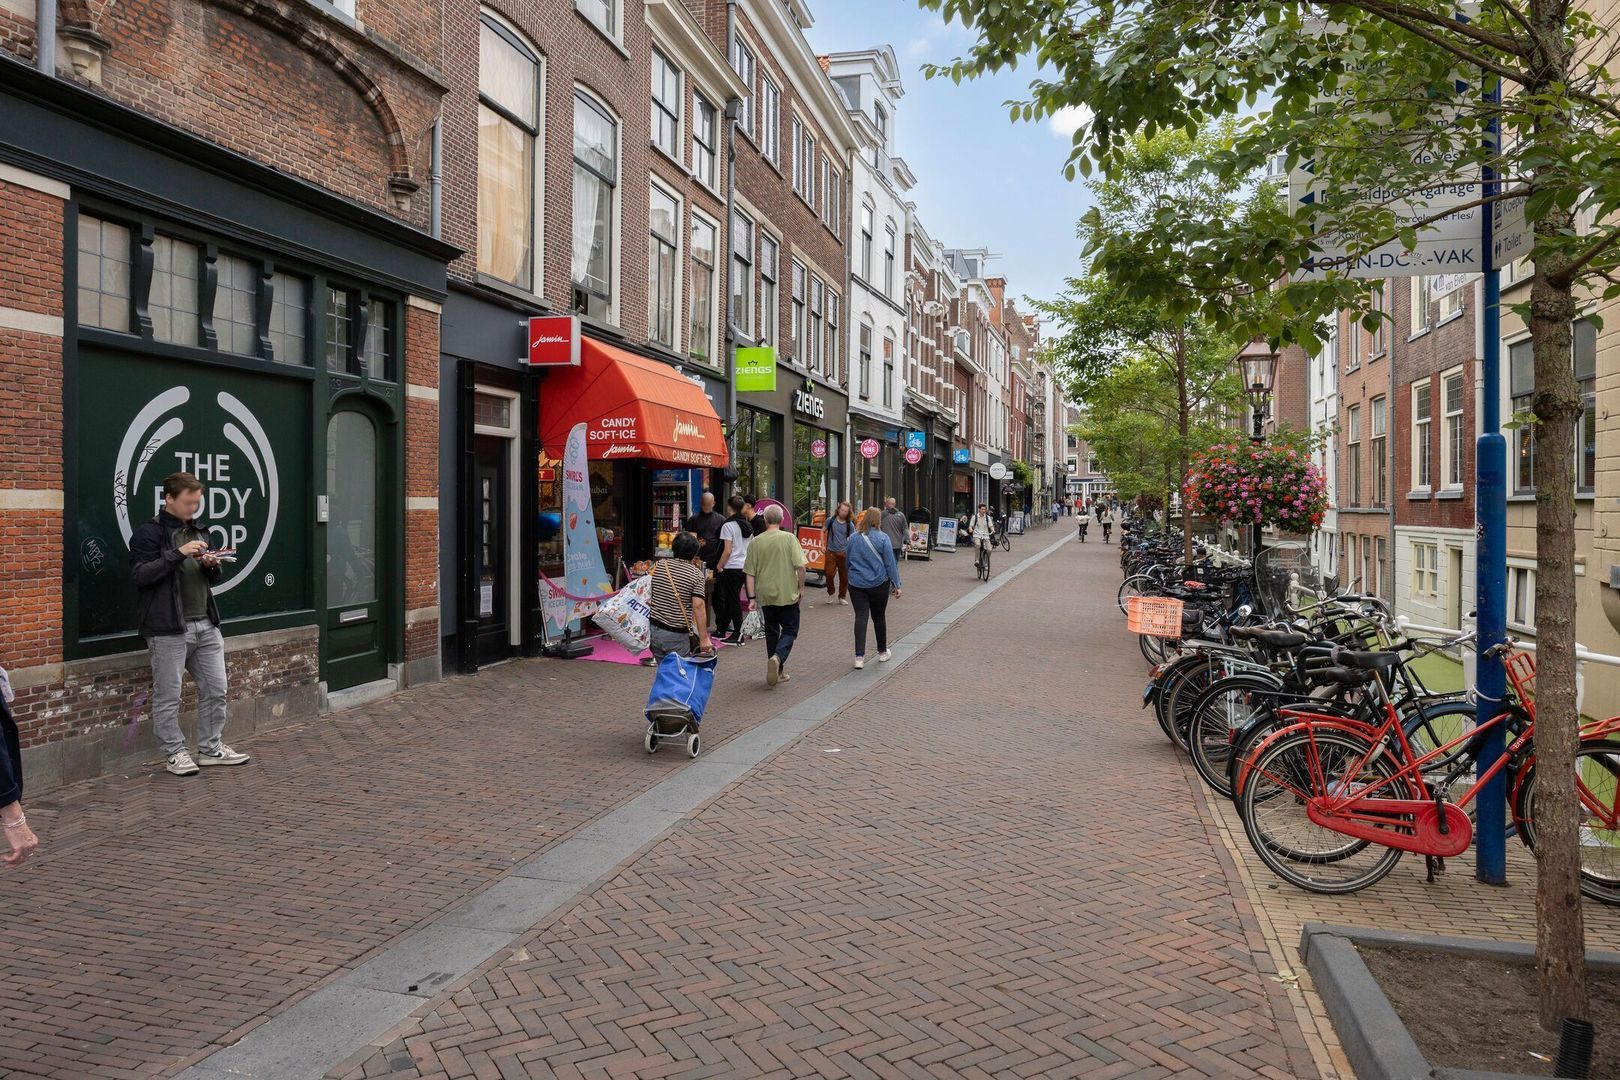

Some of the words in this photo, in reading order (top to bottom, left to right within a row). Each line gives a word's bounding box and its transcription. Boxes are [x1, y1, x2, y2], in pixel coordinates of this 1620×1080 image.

[1503, 233, 1522, 253] Toilet
[532, 334, 569, 348] jamin
[736, 366, 772, 375] ZIENGS
[796, 389, 824, 419] ZIENGS
[601, 417, 637, 428] CANDY
[672, 415, 705, 443] jamin
[589, 429, 637, 441] SOFT-ICE
[603, 444, 642, 459] jamin
[672, 450, 690, 461] CANDY
[691, 453, 712, 465] SOFT-ICE
[174, 451, 231, 482] THE
